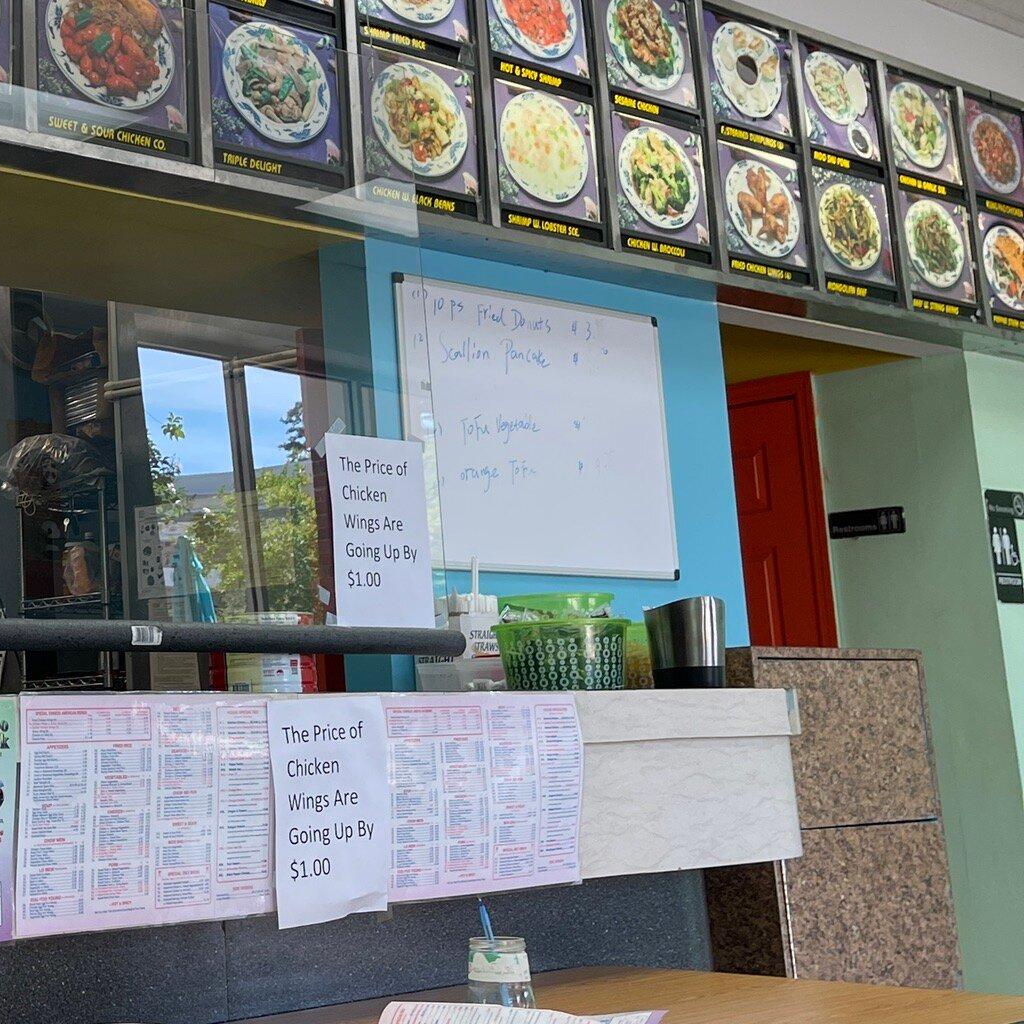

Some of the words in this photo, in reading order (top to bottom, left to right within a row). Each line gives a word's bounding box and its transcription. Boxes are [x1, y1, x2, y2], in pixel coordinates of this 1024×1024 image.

[500, 62, 514, 74] HOT
[514, 66, 520, 76] &
[522, 68, 538, 82] SPICY
[540, 73, 562, 88] SHRIMP
[614, 94, 637, 109] SESAME
[638, 102, 660, 115] CHICKEN
[48, 116, 78, 132] SWEET
[80, 122, 88, 134] &
[91, 125, 114, 139] SOUR
[116, 130, 150, 148] CHICKEN
[153, 138, 166, 150] CO.
[223, 152, 248, 167] TRIPLE
[250, 158, 282, 175] DELIGHT
[372, 186, 399, 200] CHICKEN
[434, 198, 456, 212] BEANS
[508, 214, 532, 226] SHRIMP
[542, 221, 567, 234] LOBSTER
[568, 226, 580, 238] SCE.
[628, 238, 650, 250] CHICKEN
[340, 456, 361, 473] The
[365, 459, 393, 476] Price
[397, 462, 408, 476] of
[342, 484, 387, 503] Chicken
[344, 514, 380, 534] Wings
[384, 516, 404, 532] Are
[346, 542, 380, 562] Going
[384, 544, 400, 562] Up
[404, 545, 418, 563] By
[348, 569, 382, 588] $1.00
[282, 726, 310, 744] The
[314, 724, 346, 742] Price
[350, 720, 364, 739] of
[287, 757, 340, 778] Chicken
[288, 794, 330, 812] Wings
[334, 790, 358, 806] Are
[289, 826, 330, 846] Going
[334, 822, 354, 844] Up
[358, 820, 374, 840] By
[290, 857, 330, 881] $1.00
